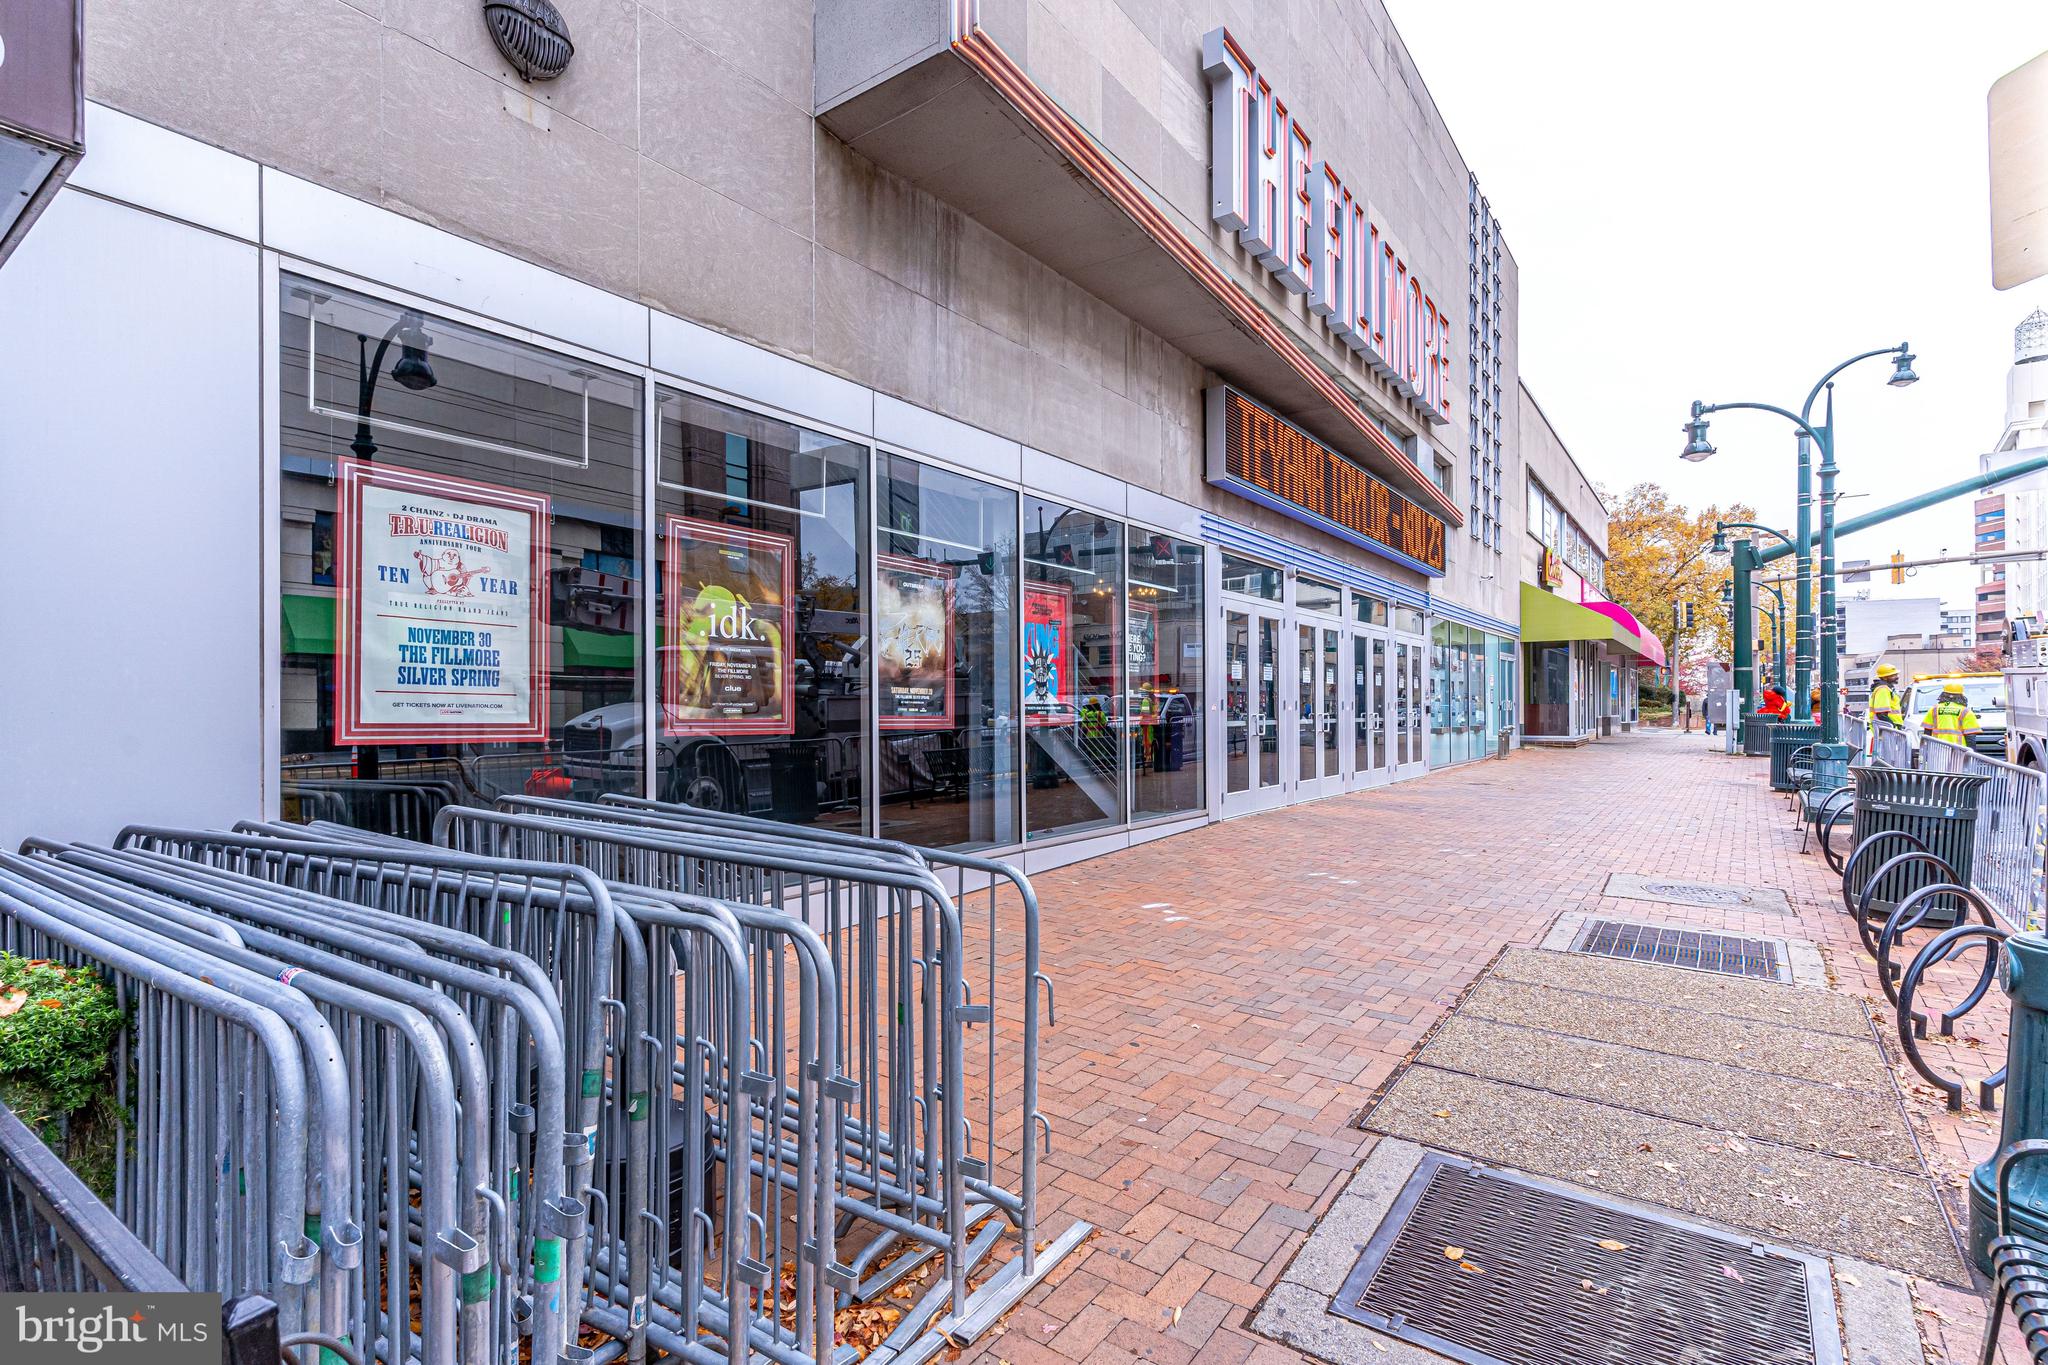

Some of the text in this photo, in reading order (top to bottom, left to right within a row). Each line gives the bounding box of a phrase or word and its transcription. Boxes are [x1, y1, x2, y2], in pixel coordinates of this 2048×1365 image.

[1203, 26, 1451, 425] THE FILLMORE
[1236, 396, 1325, 516] TEYANA
[1328, 453, 1391, 546] TAYLOR
[1402, 499, 1427, 561] NOV
[1427, 514, 1443, 569] 23
[410, 506, 444, 517] CHAINZ
[453, 511, 464, 520] DJ
[467, 515, 498, 526] DRAMA
[420, 539, 482, 552] ANNIVERSARY TOUR
[378, 565, 518, 595] TEN YEAR
[408, 627, 492, 648] NOVEMBER 30
[399, 644, 500, 667] THE FILLMORE
[1129, 653, 1146, 662] TING?
[1132, 644, 1145, 653] YOU
[398, 666, 500, 687] SILVER SPRING
